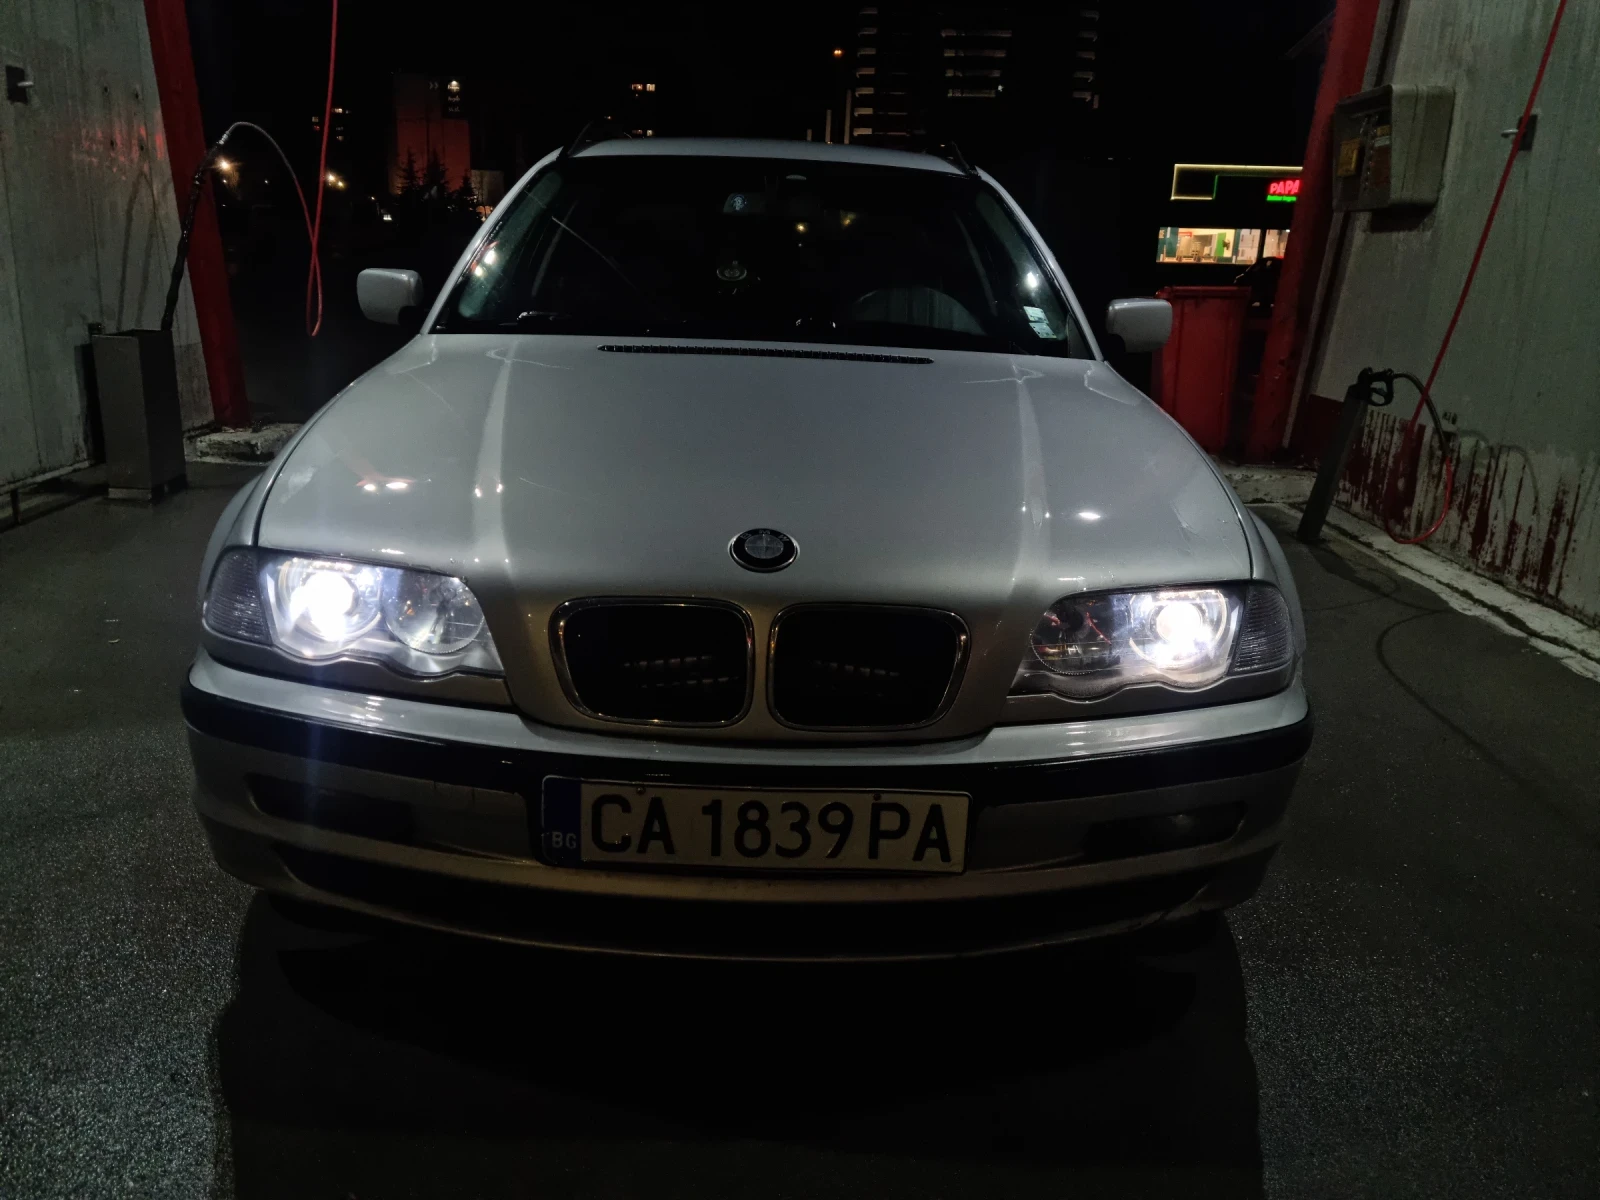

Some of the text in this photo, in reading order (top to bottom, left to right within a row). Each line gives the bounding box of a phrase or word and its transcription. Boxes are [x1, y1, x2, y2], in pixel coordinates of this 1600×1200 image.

[1269, 180, 1299, 194] PAPA
[591, 794, 952, 863] CA 1839 PA
[552, 831, 577, 850] BG
